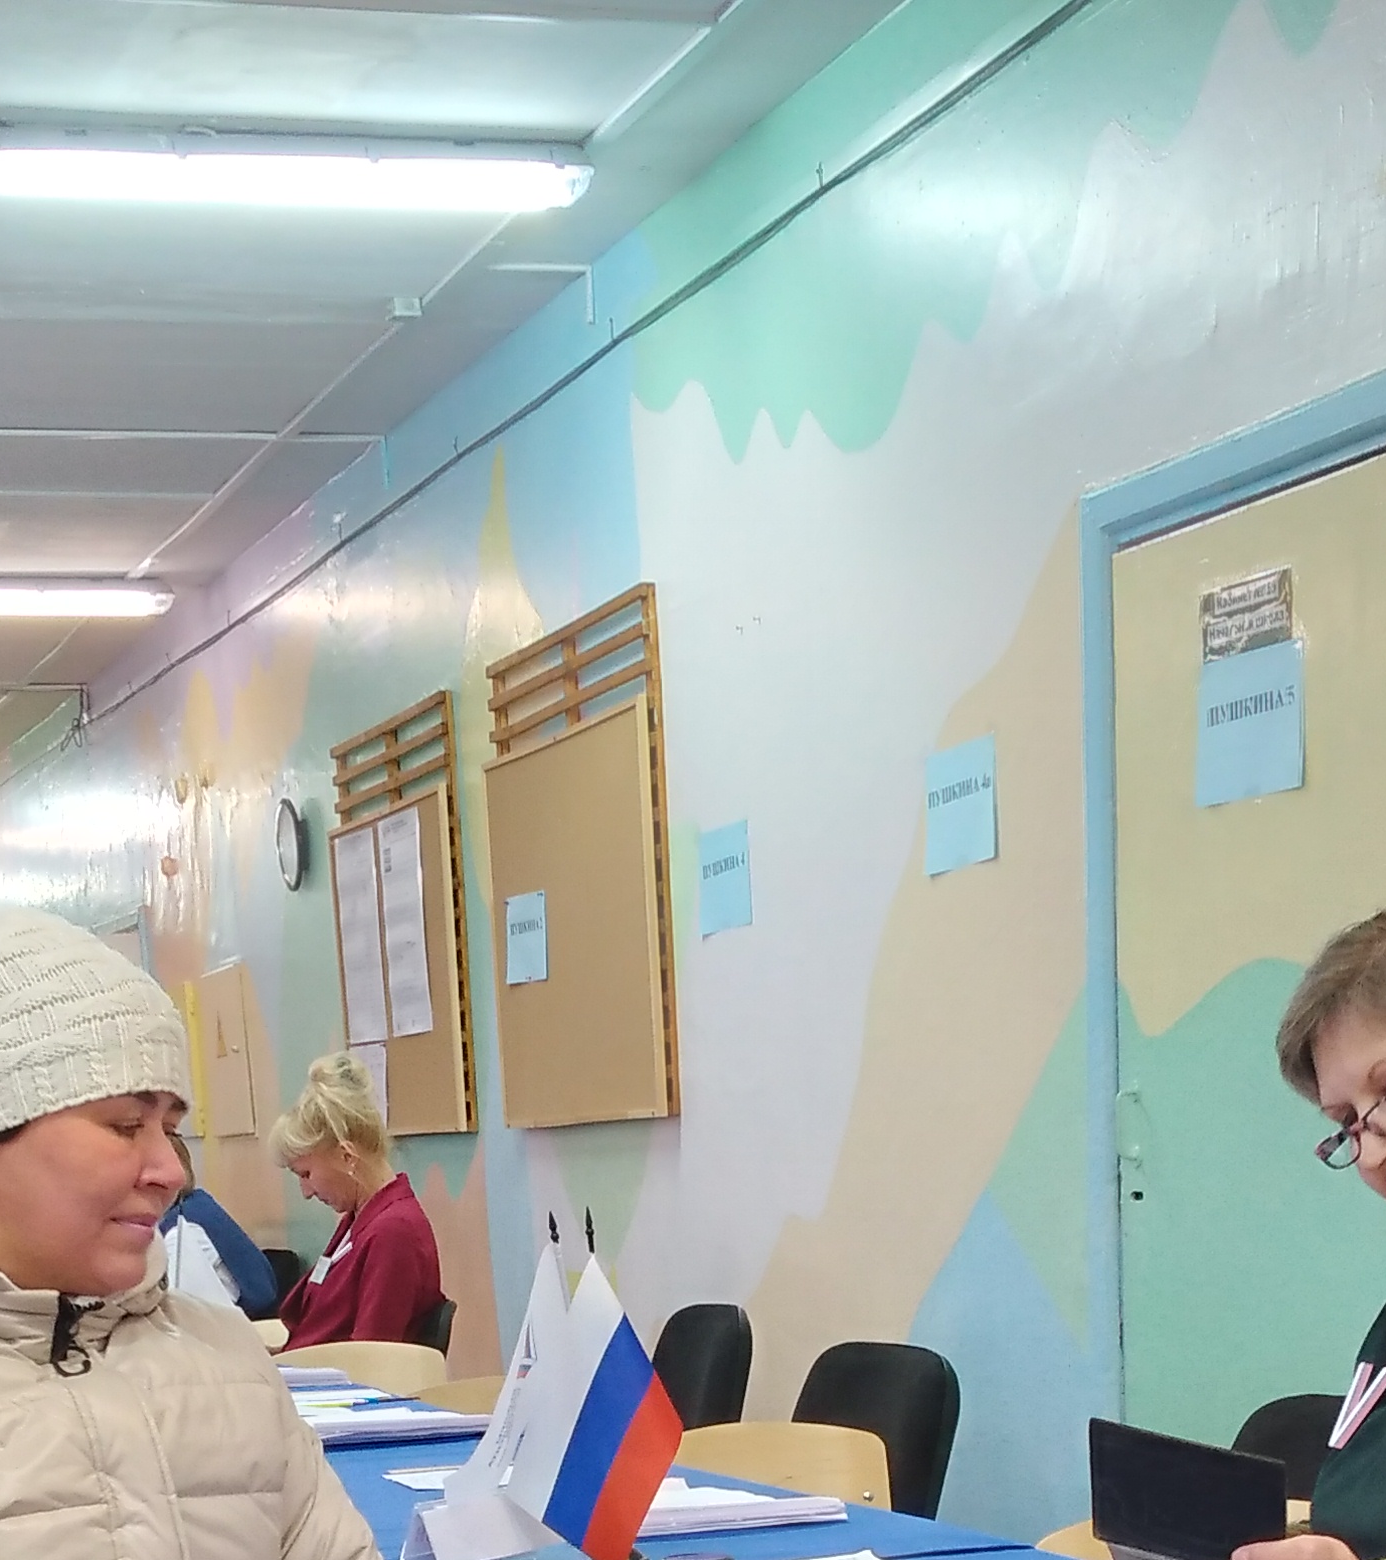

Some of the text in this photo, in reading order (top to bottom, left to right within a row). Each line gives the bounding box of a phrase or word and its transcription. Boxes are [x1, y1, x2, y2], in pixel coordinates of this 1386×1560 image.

[1207, 684, 1295, 728] ПУШКИНА 5
[927, 776, 980, 810] ПУШКИНА
